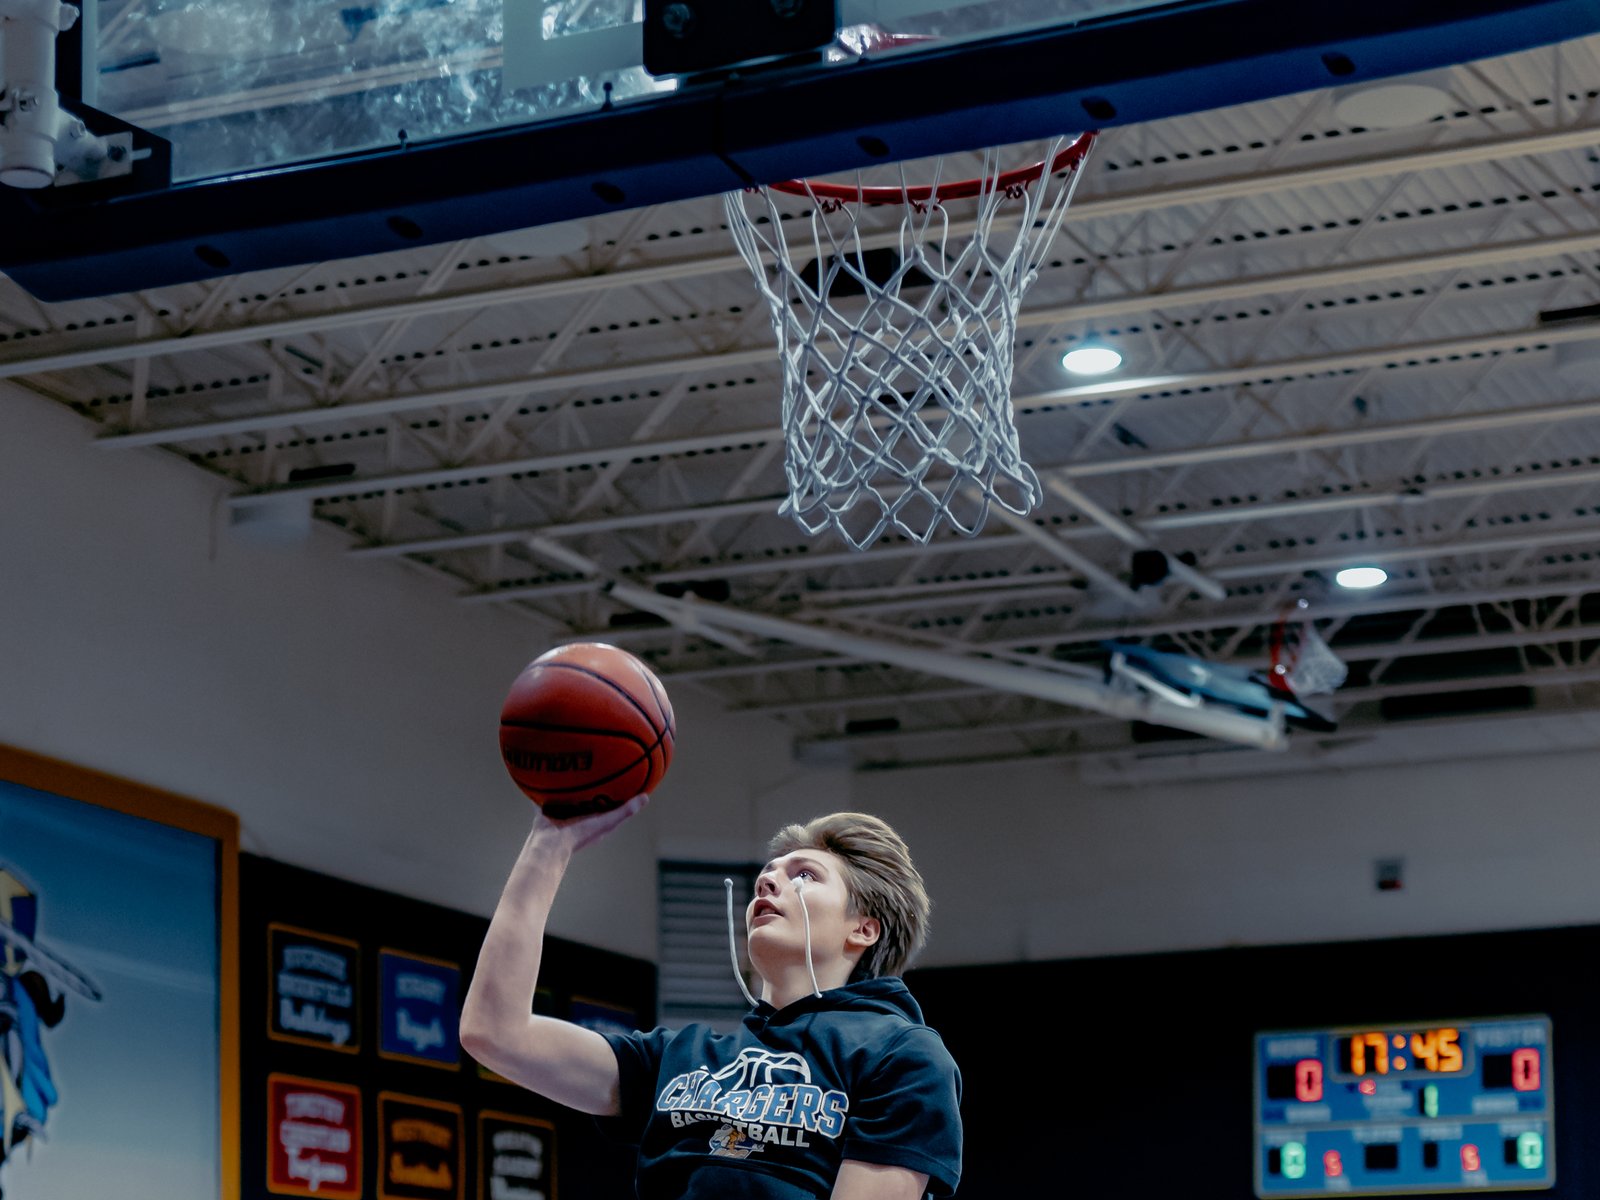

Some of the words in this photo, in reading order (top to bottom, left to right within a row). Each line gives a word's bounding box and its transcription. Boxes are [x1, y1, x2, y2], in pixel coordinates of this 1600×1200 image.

[1296, 1059, 1323, 1102] 0
[1512, 1048, 1540, 1091] 0
[1351, 1028, 1463, 1075] 17:45
[656, 1070, 849, 1139] CHARGERS
[670, 1111, 810, 1148] BASTBALL
